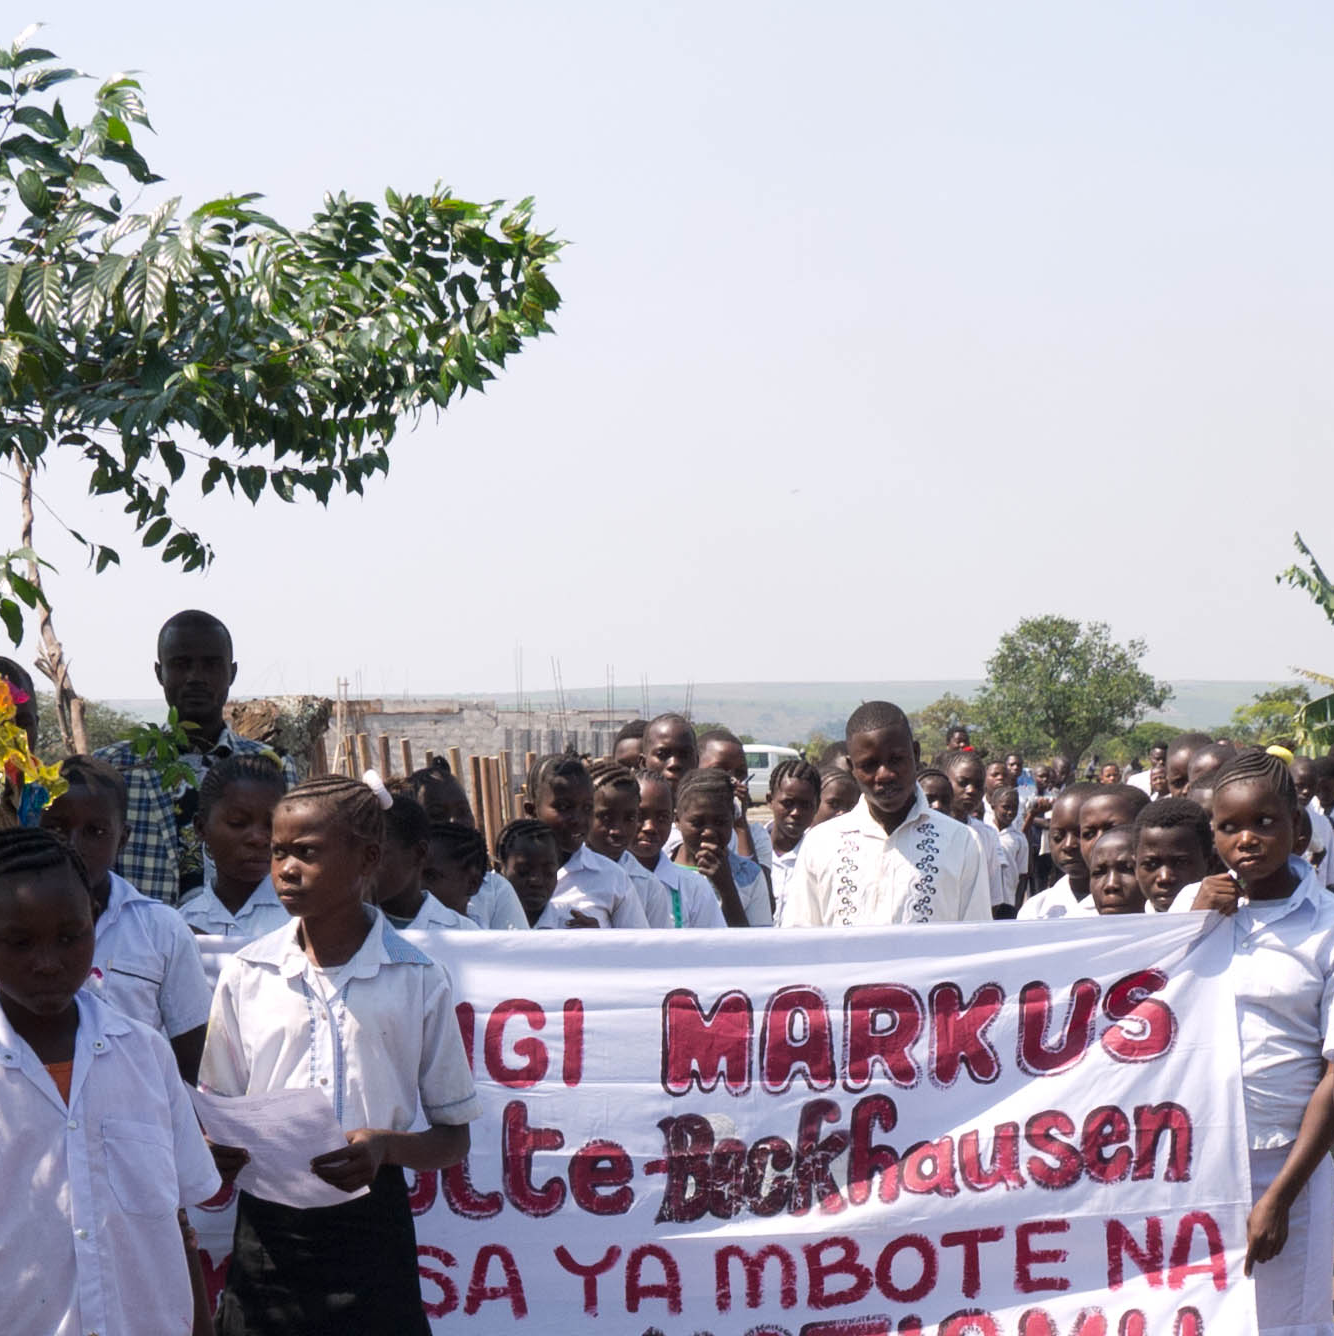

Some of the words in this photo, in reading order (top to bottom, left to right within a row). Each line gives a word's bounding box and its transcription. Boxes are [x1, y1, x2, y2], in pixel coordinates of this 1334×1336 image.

[661, 968, 1179, 1097] MARKUS
[554, 1244, 681, 1316] YA
[1106, 1211, 1228, 1292] NA
